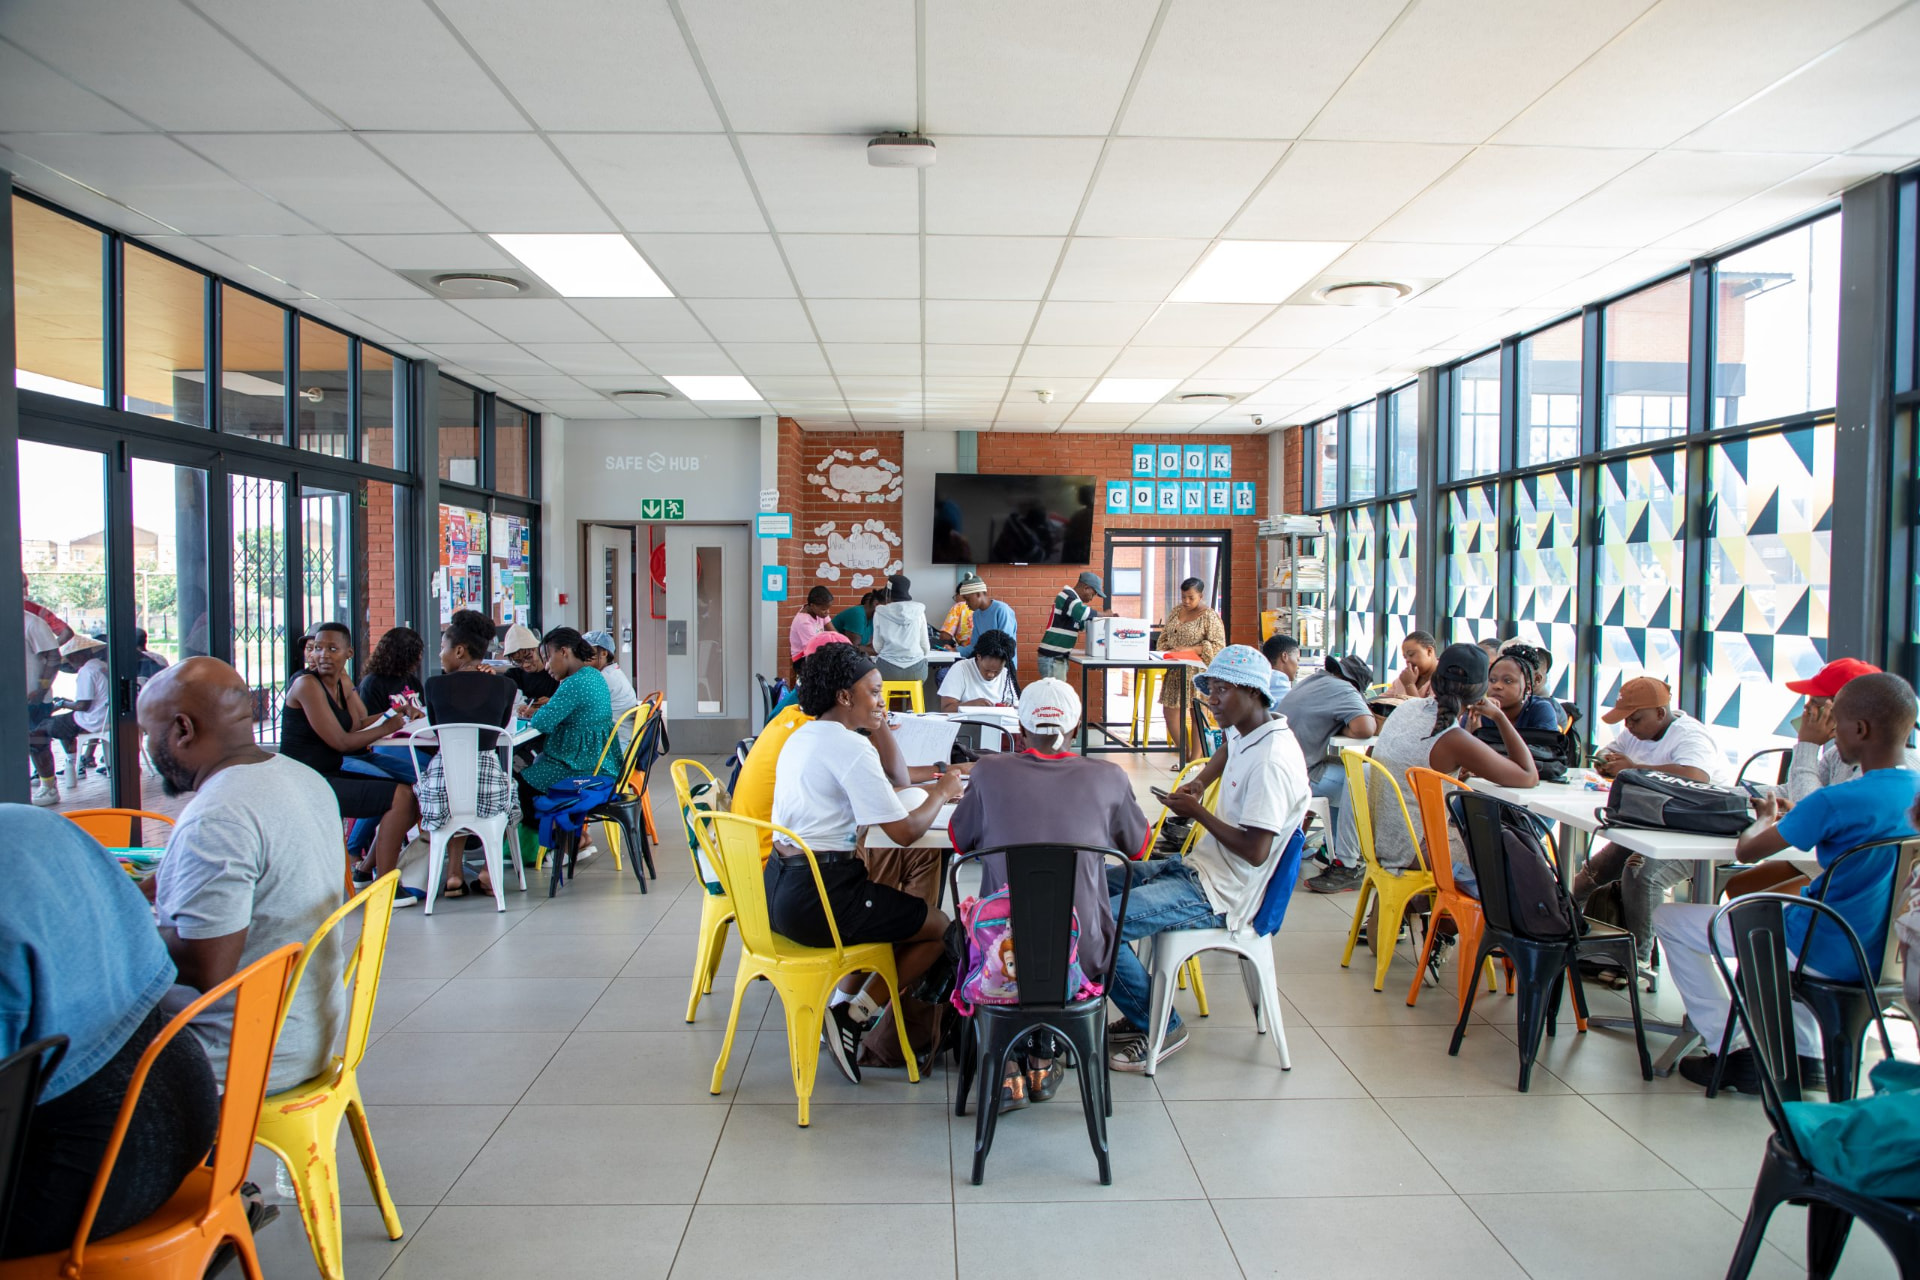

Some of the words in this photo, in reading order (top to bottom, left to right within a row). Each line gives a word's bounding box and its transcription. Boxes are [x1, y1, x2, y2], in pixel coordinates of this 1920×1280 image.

[605, 456, 643, 470] SAFE
[669, 456, 700, 471] HUB
[1138, 454, 1226, 470] BOOK
[1112, 491, 1251, 506] CORNER
